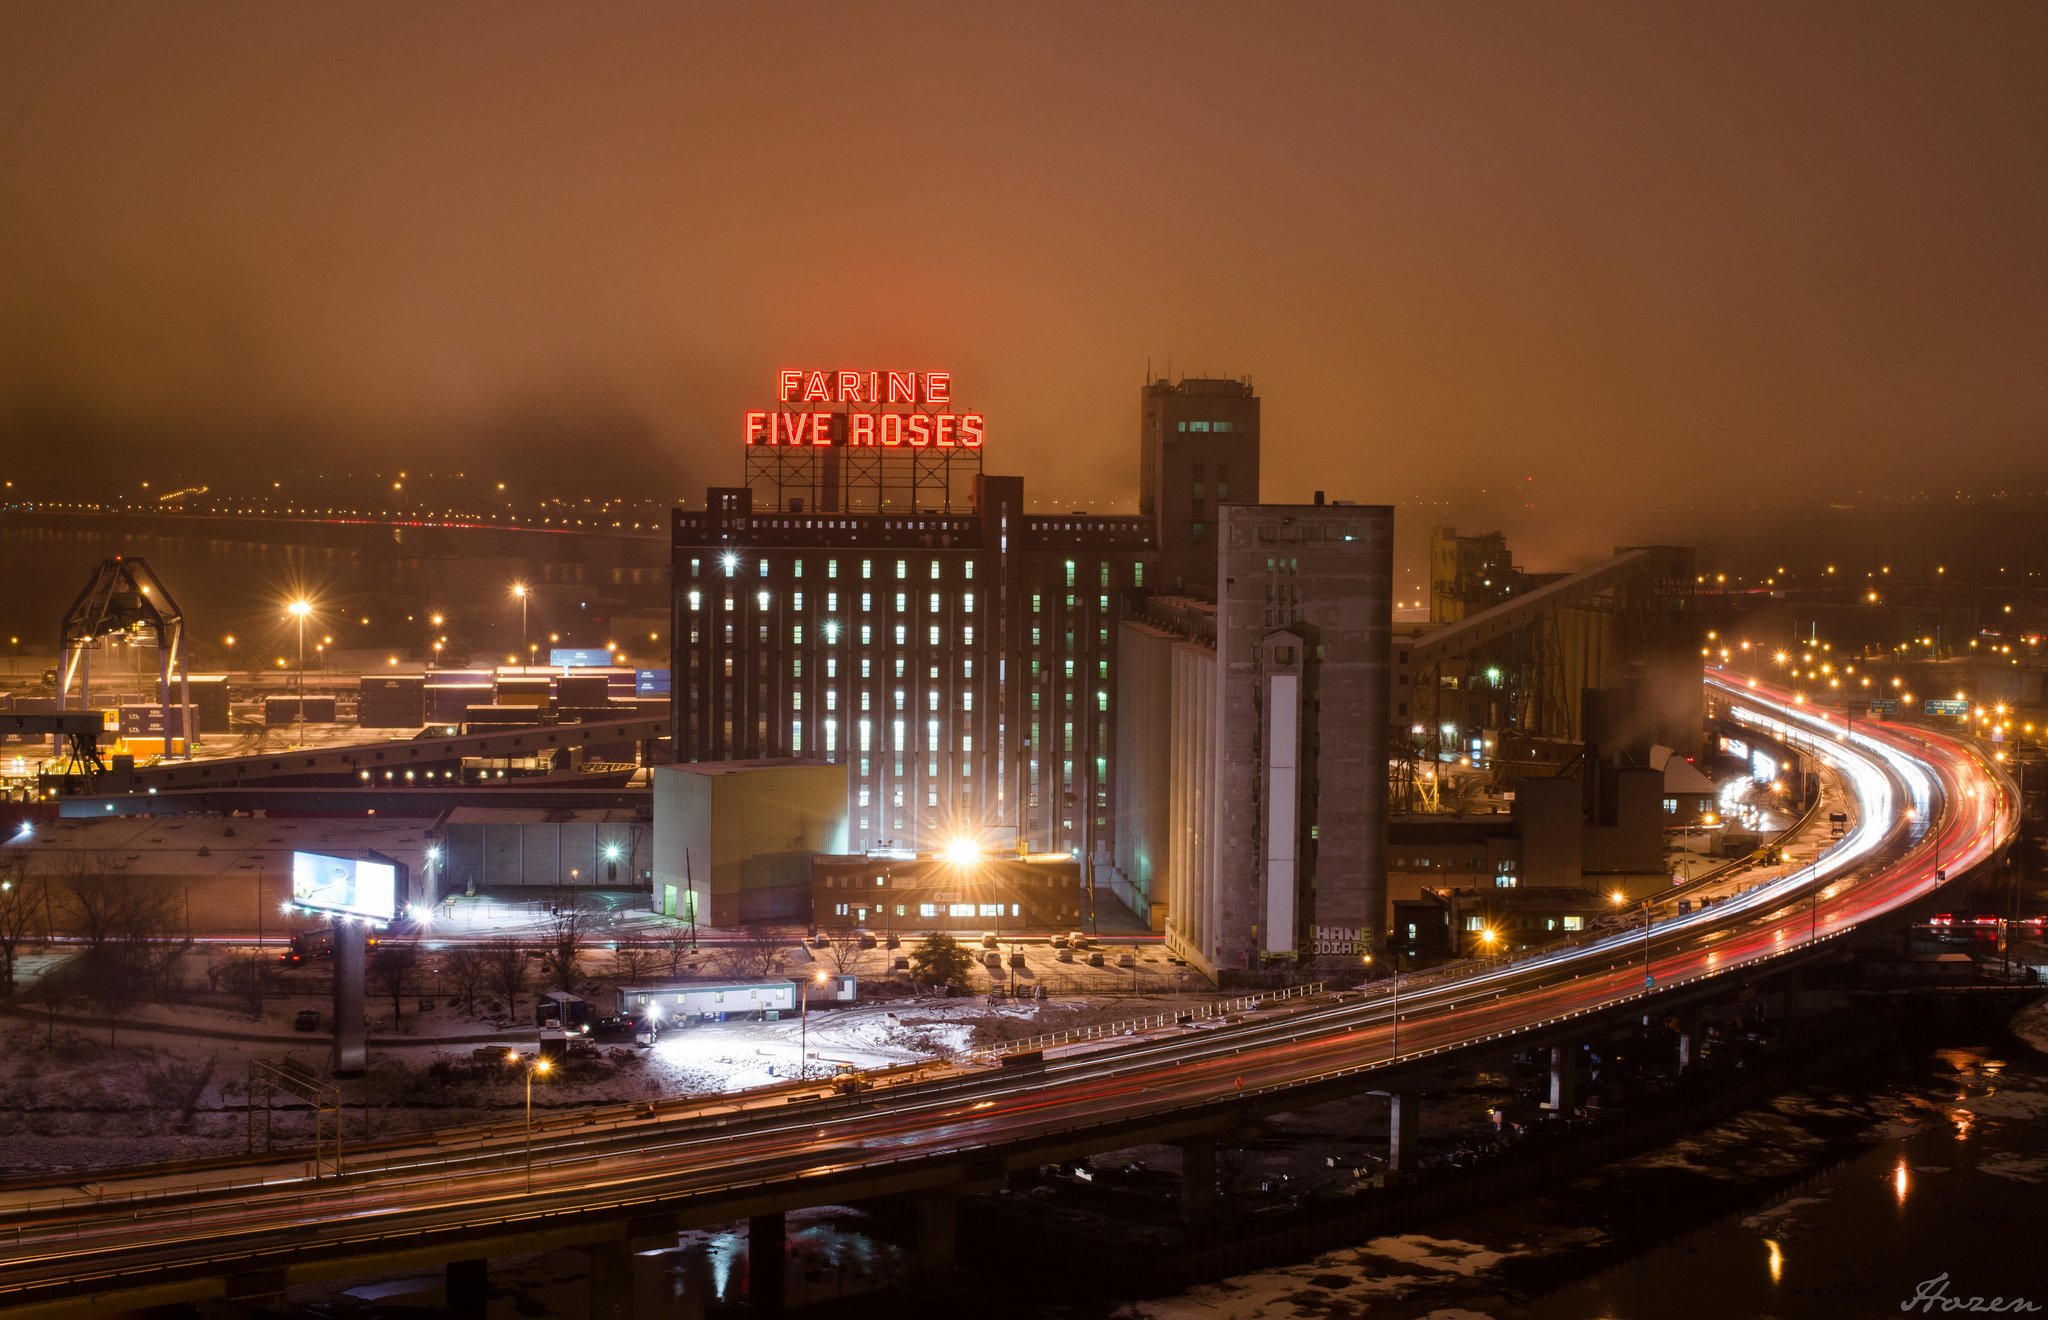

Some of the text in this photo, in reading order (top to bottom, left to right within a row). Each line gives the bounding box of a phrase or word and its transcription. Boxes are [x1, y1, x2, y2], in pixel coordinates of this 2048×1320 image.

[779, 369, 951, 403] FARINE
[746, 411, 984, 448] FIVE ROSES
[1654, 577, 1695, 586] CANADA
